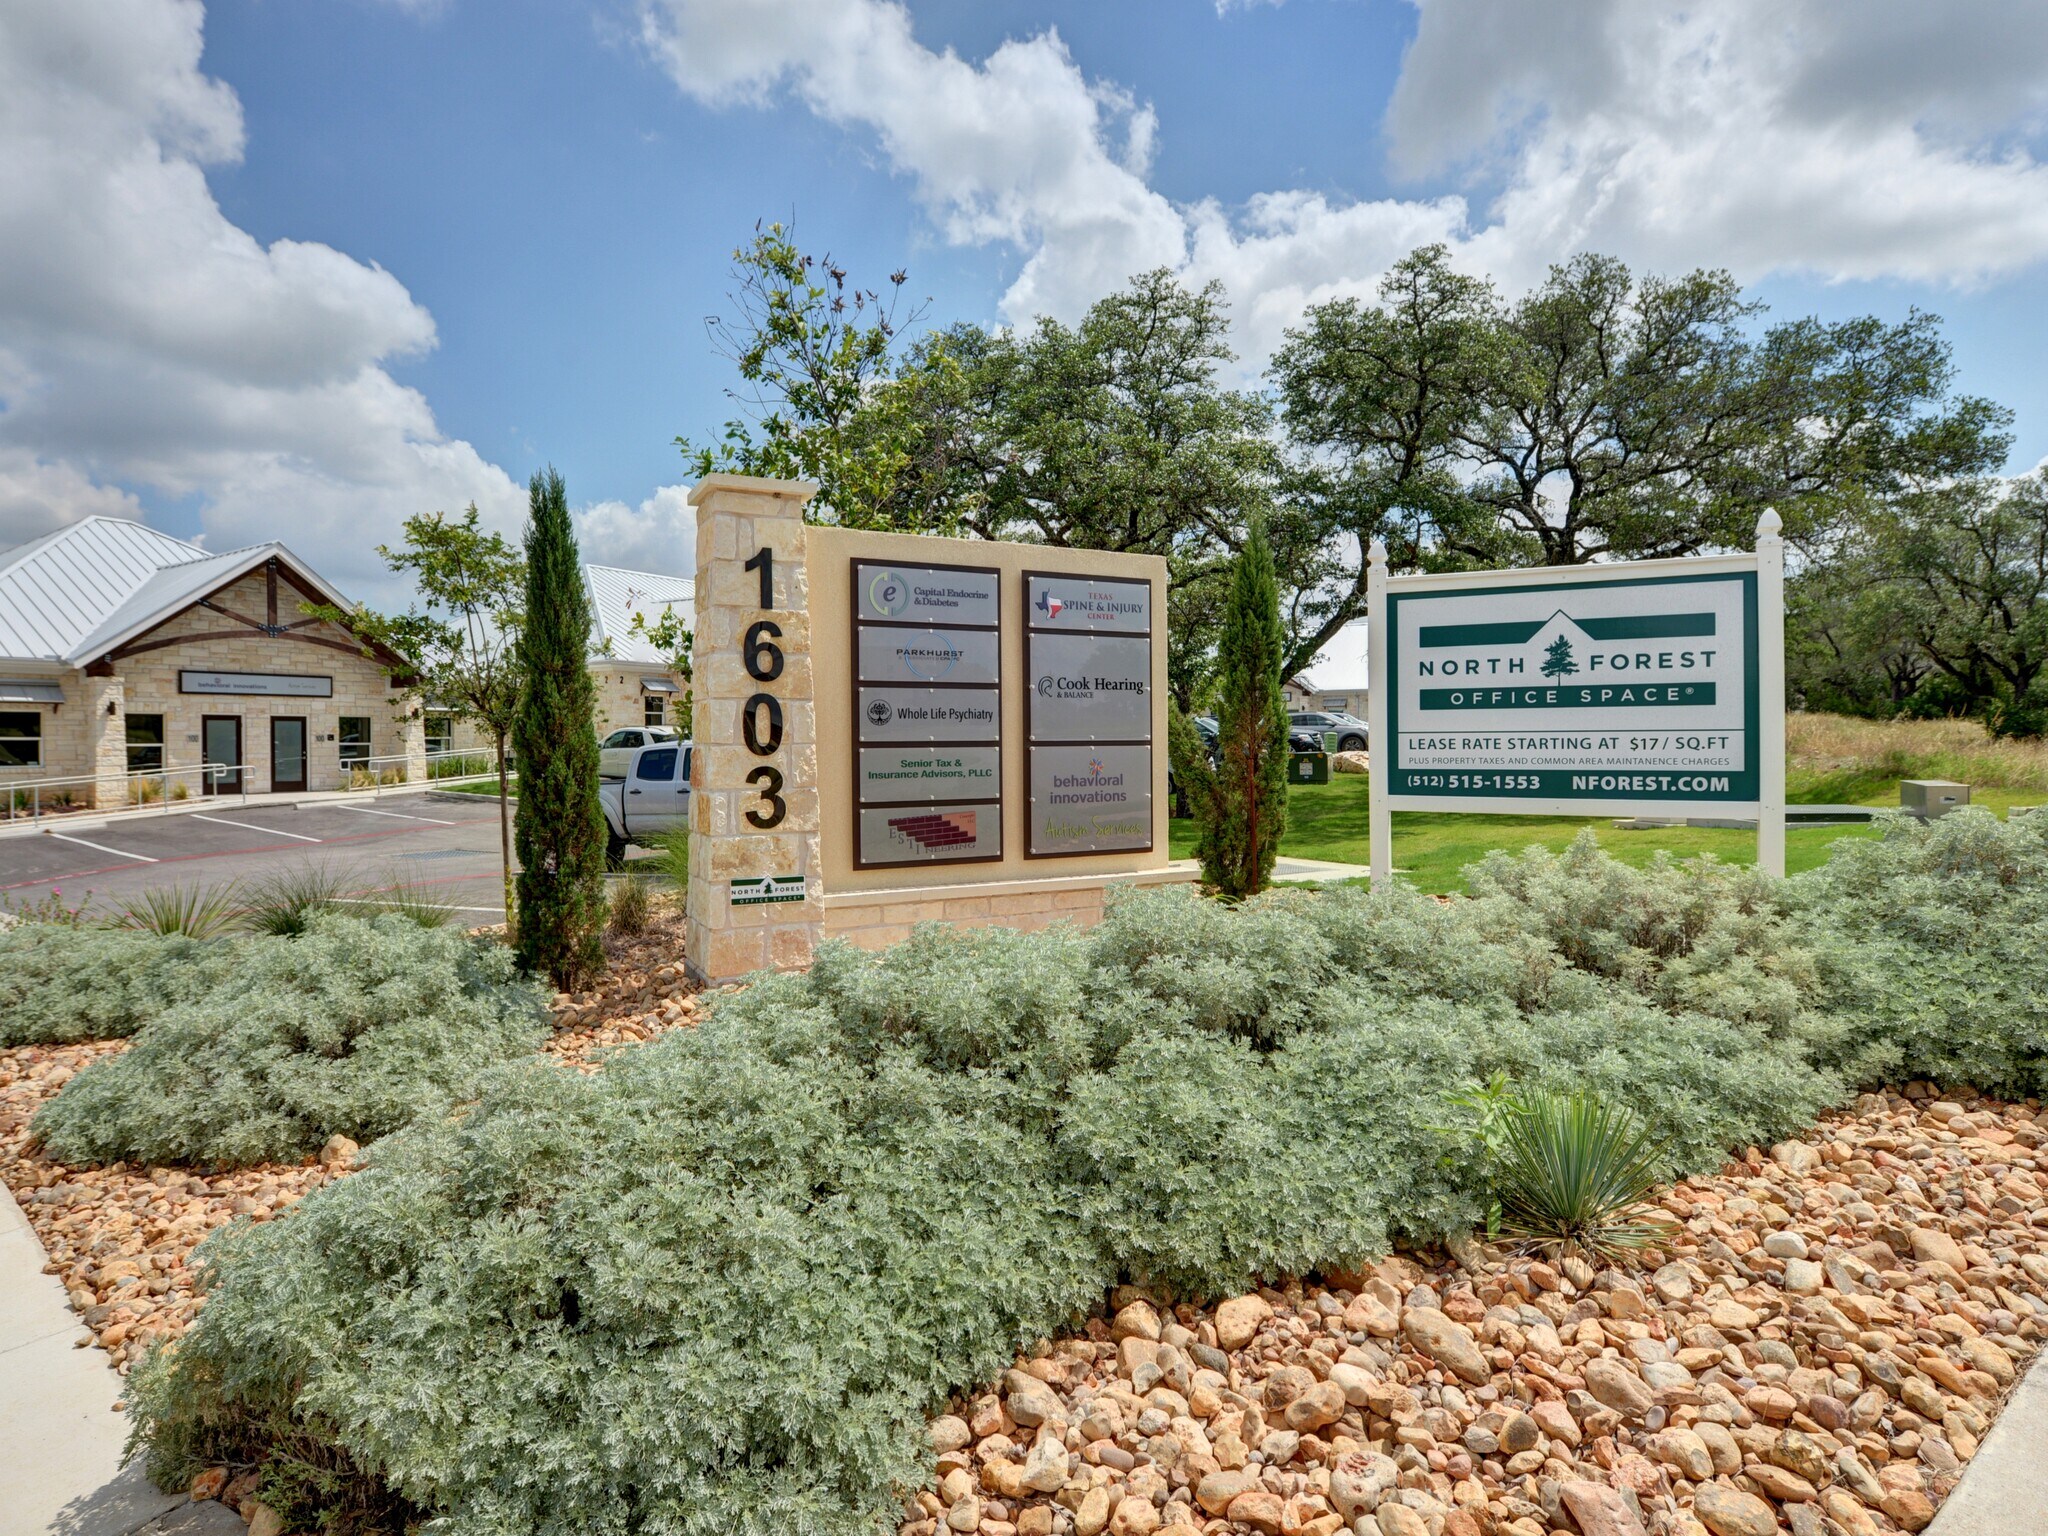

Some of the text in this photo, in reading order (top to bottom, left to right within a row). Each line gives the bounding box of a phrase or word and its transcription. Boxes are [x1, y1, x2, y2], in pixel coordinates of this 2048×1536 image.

[914, 587, 989, 600] Capital Endocrine
[1088, 592, 1113, 600] TEXAS
[1064, 600, 1144, 615] SPINE & INJURY
[896, 649, 964, 657] PARKHURST
[1419, 650, 1717, 677] NORTH FOREST
[743, 547, 786, 829] 1603
[1057, 677, 1144, 695] Cook Hearing
[1450, 690, 1558, 705] OFFICE
[897, 707, 993, 722] Whole Life Psychiatry
[1409, 738, 1457, 750] LEASE
[1462, 738, 1502, 750] RATE
[1507, 737, 1592, 750] STARTING
[1598, 737, 1619, 750] AT
[1675, 736, 1730, 750] SQ.FT
[900, 759, 962, 768] Senior Tax &
[1408, 757, 1730, 766] PLUS PROPERTY TAXES AND COMMON AREA MAINTANENCE CHARGES
[868, 769, 992, 780] Insurance Advisors, PLLC
[1053, 773, 1124, 788] behavioral
[1407, 775, 1541, 789] (512) 515-1553
[1572, 775, 1730, 792] NFOREST.COM
[1050, 790, 1127, 804] innovations
[1044, 815, 1143, 839] Autism Services
[731, 885, 804, 896] NORTH FOREST
